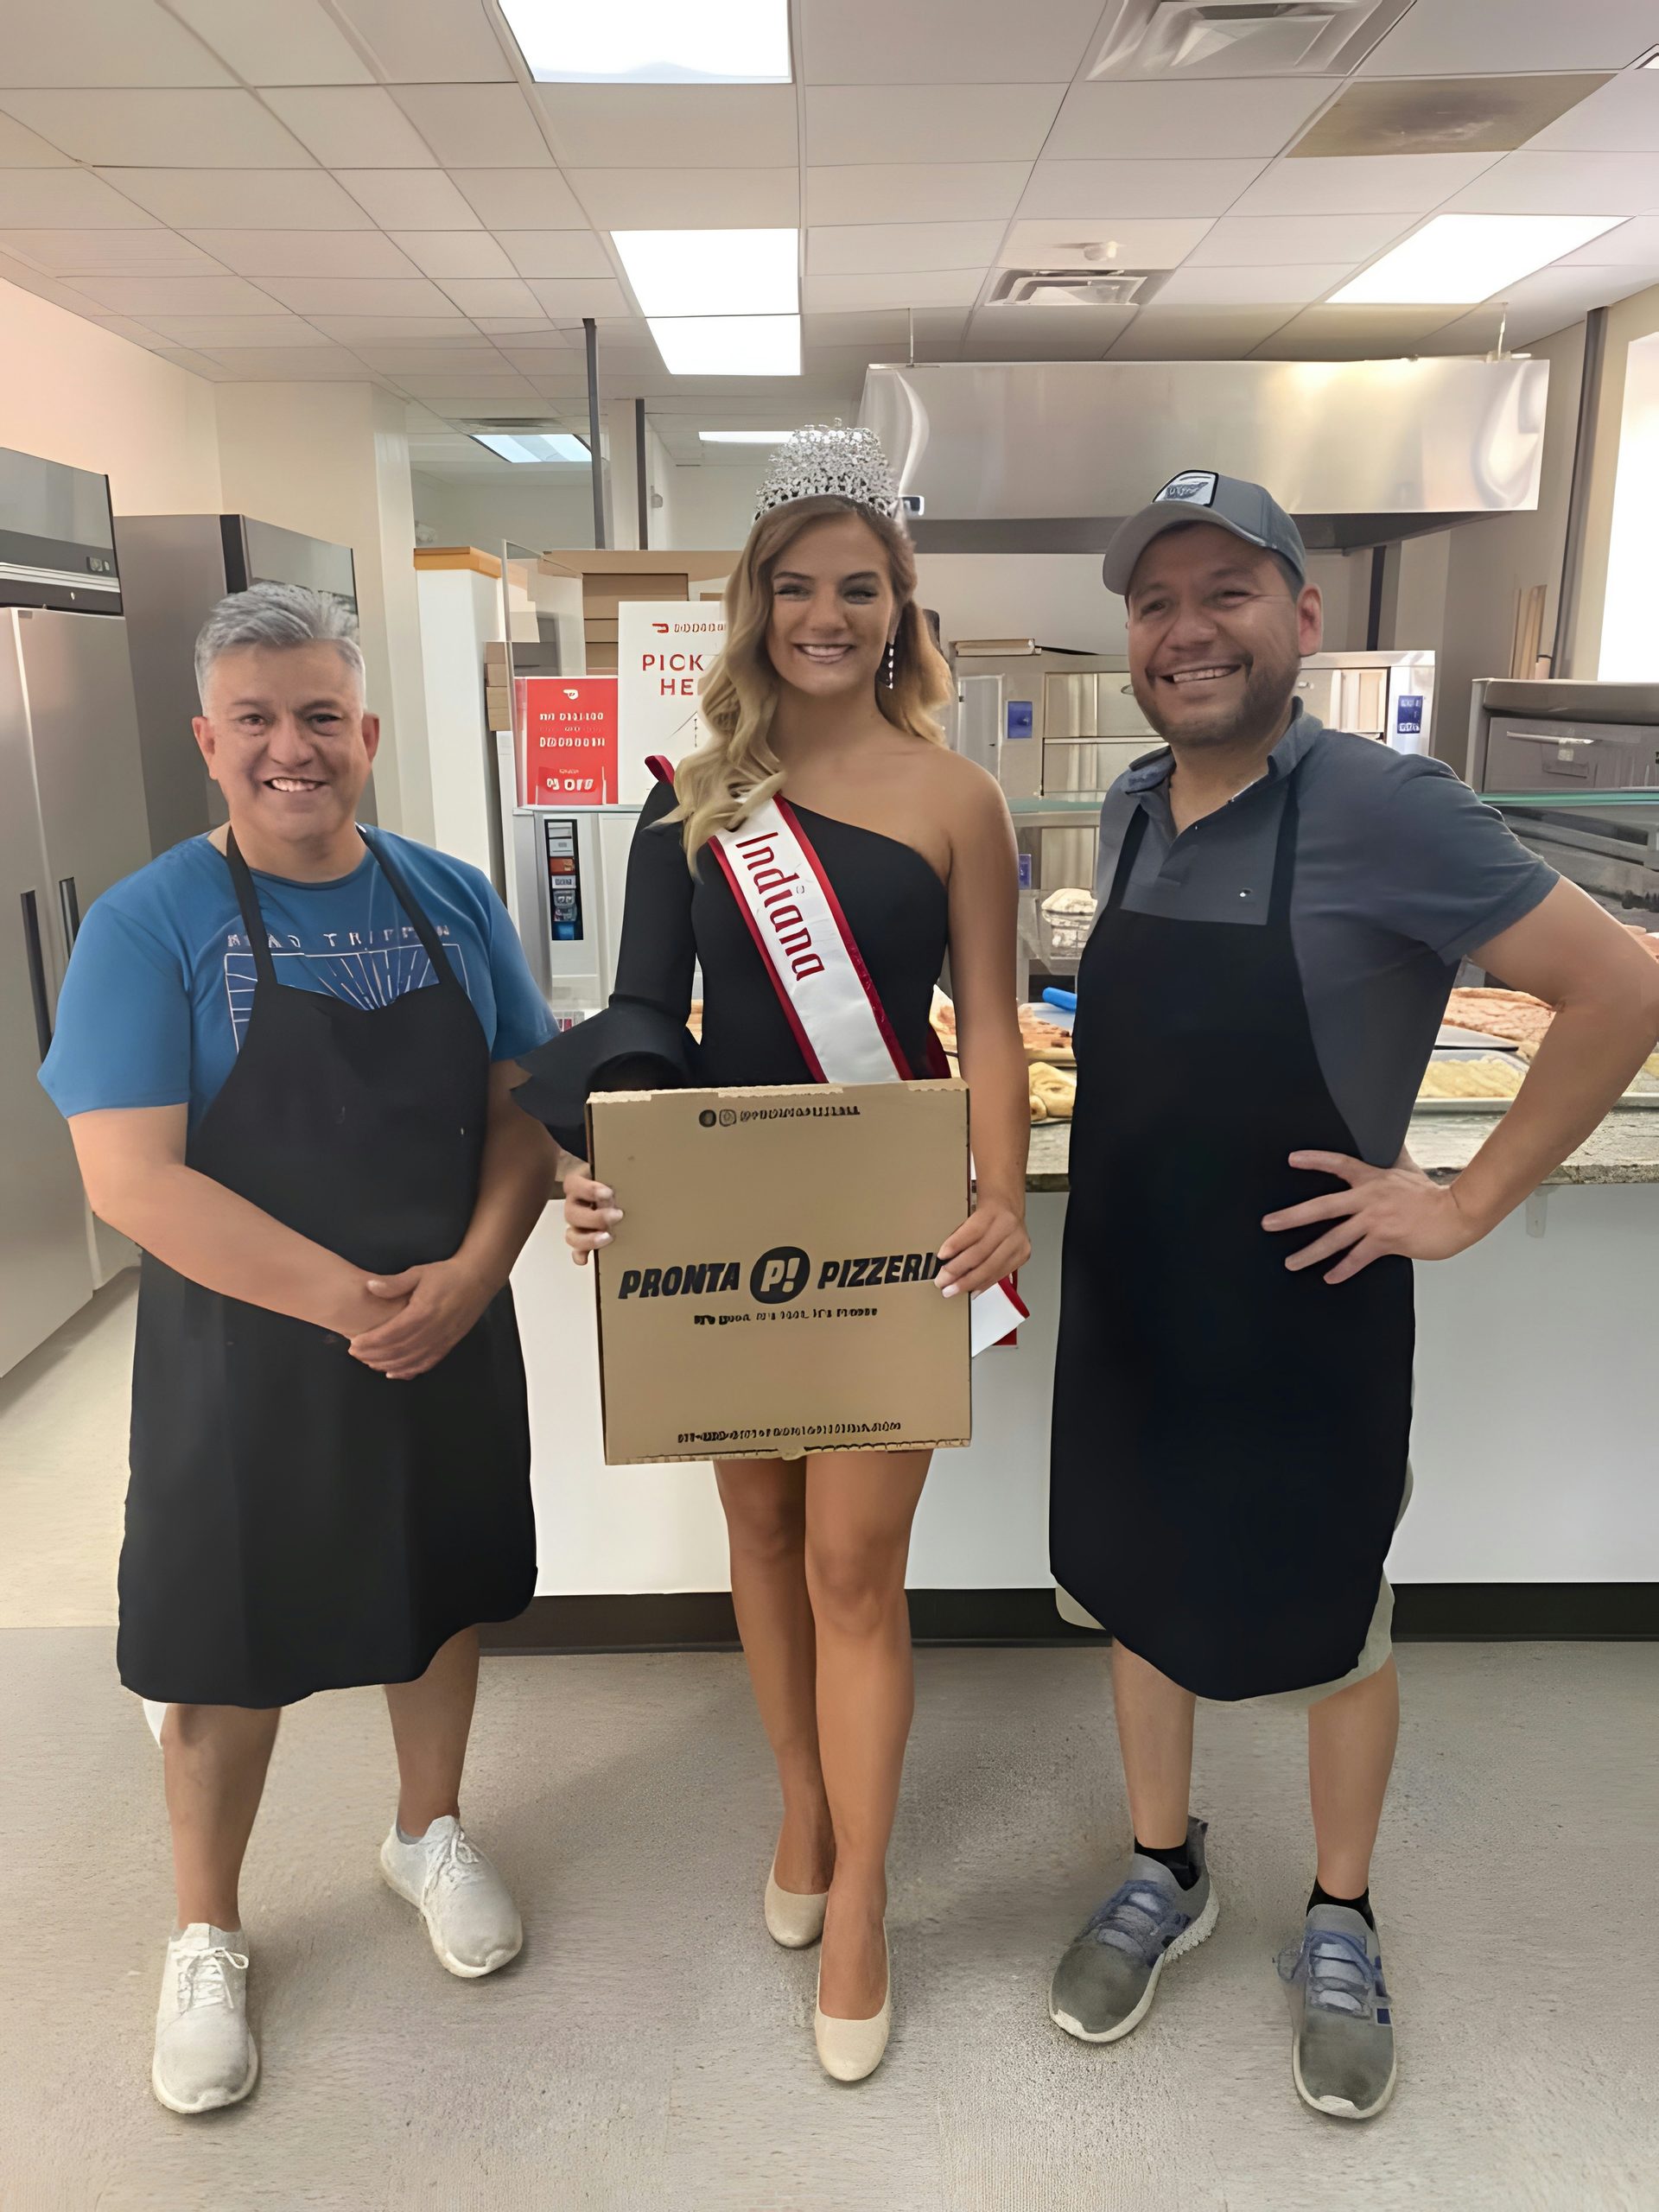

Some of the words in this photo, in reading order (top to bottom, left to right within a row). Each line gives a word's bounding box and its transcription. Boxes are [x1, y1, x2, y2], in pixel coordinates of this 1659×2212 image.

[660, 678, 694, 696] HE
[735, 831, 825, 982] Indiana
[618, 1262, 741, 1300] PRONTA
